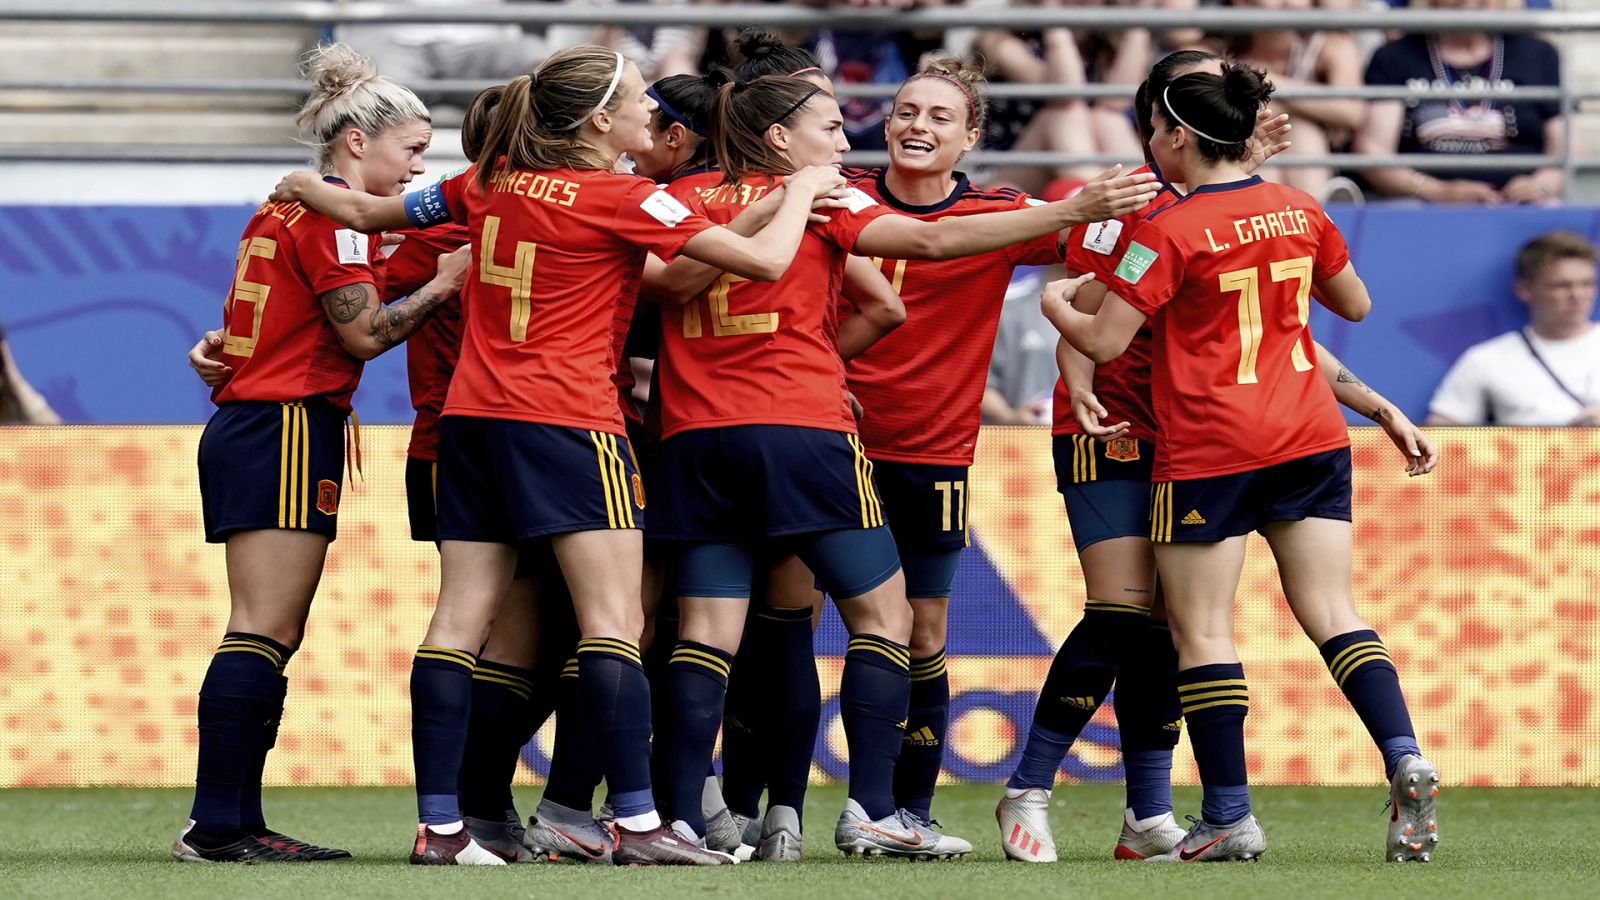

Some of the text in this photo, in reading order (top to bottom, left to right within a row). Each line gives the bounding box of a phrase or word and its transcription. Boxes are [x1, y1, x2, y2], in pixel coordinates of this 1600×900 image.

[1205, 205, 1311, 253] L. GARCÍA
[479, 215, 537, 343] 4
[682, 272, 779, 339] 2
[1218, 256, 1315, 385] 17
[934, 480, 965, 532] 11
